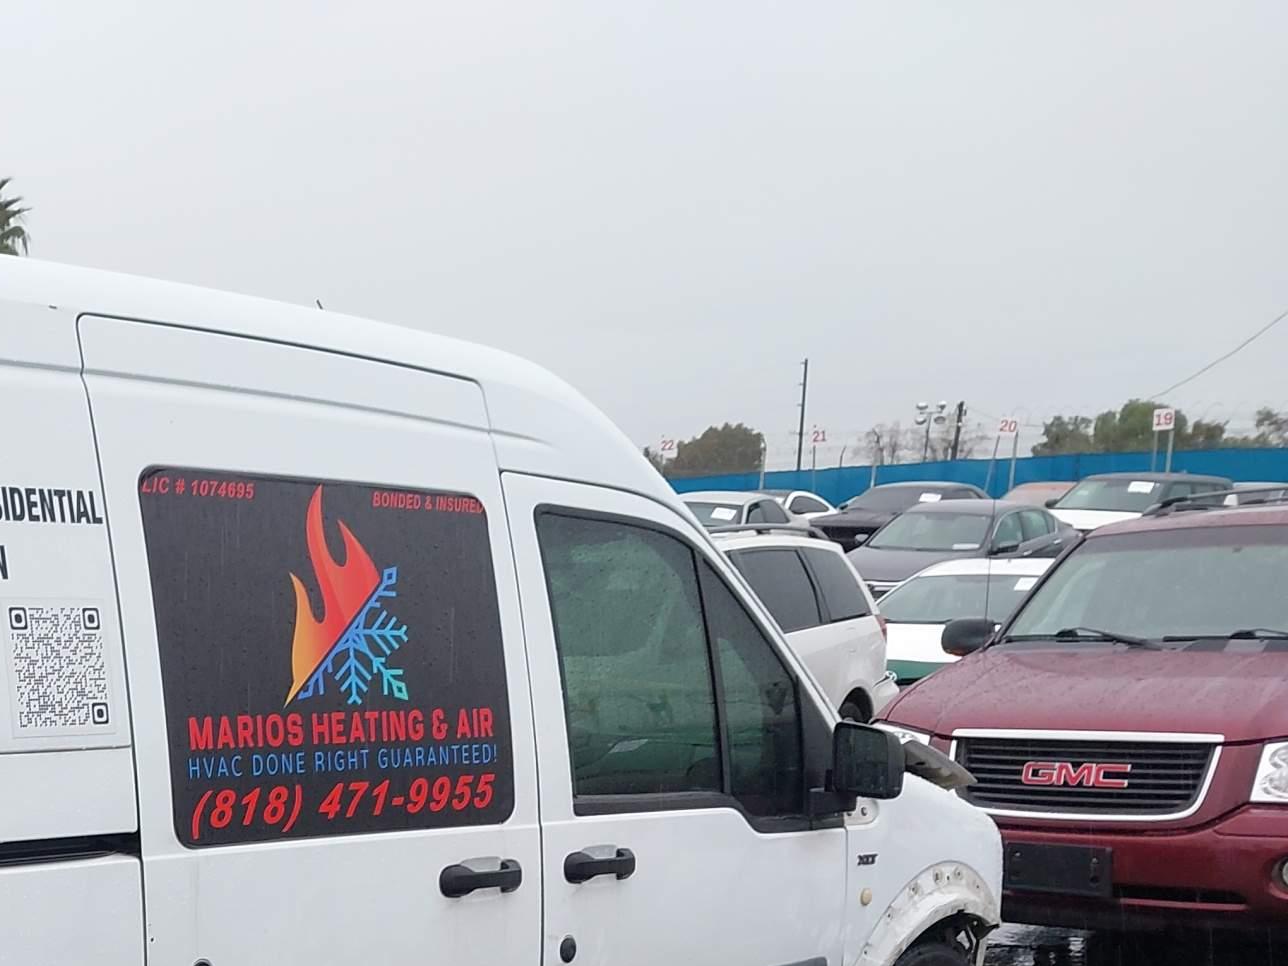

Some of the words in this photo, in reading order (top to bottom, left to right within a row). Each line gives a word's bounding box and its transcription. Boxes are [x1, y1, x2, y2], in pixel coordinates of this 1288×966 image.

[1000, 420, 1017, 432] 20
[1155, 413, 1173, 426] 19
[662, 440, 674, 450] 22
[812, 431, 826, 442] 21
[142, 478, 169, 494] LIC
[175, 478, 185, 494] #
[192, 480, 254, 499] 1074695
[373, 491, 421, 510] BONDED
[425, 495, 432, 510] &
[188, 713, 304, 750] MARIOS
[312, 710, 425, 745] HEATING
[432, 708, 448, 739] &
[456, 708, 494, 738] AIR
[188, 756, 242, 780] HVAC
[252, 752, 306, 775] DONE
[315, 749, 369, 772] RIGHT
[378, 744, 498, 769] GUARANTEED!
[1022, 761, 1132, 788] GMC
[192, 785, 303, 840] (818)
[318, 774, 496, 820] 471-9955
